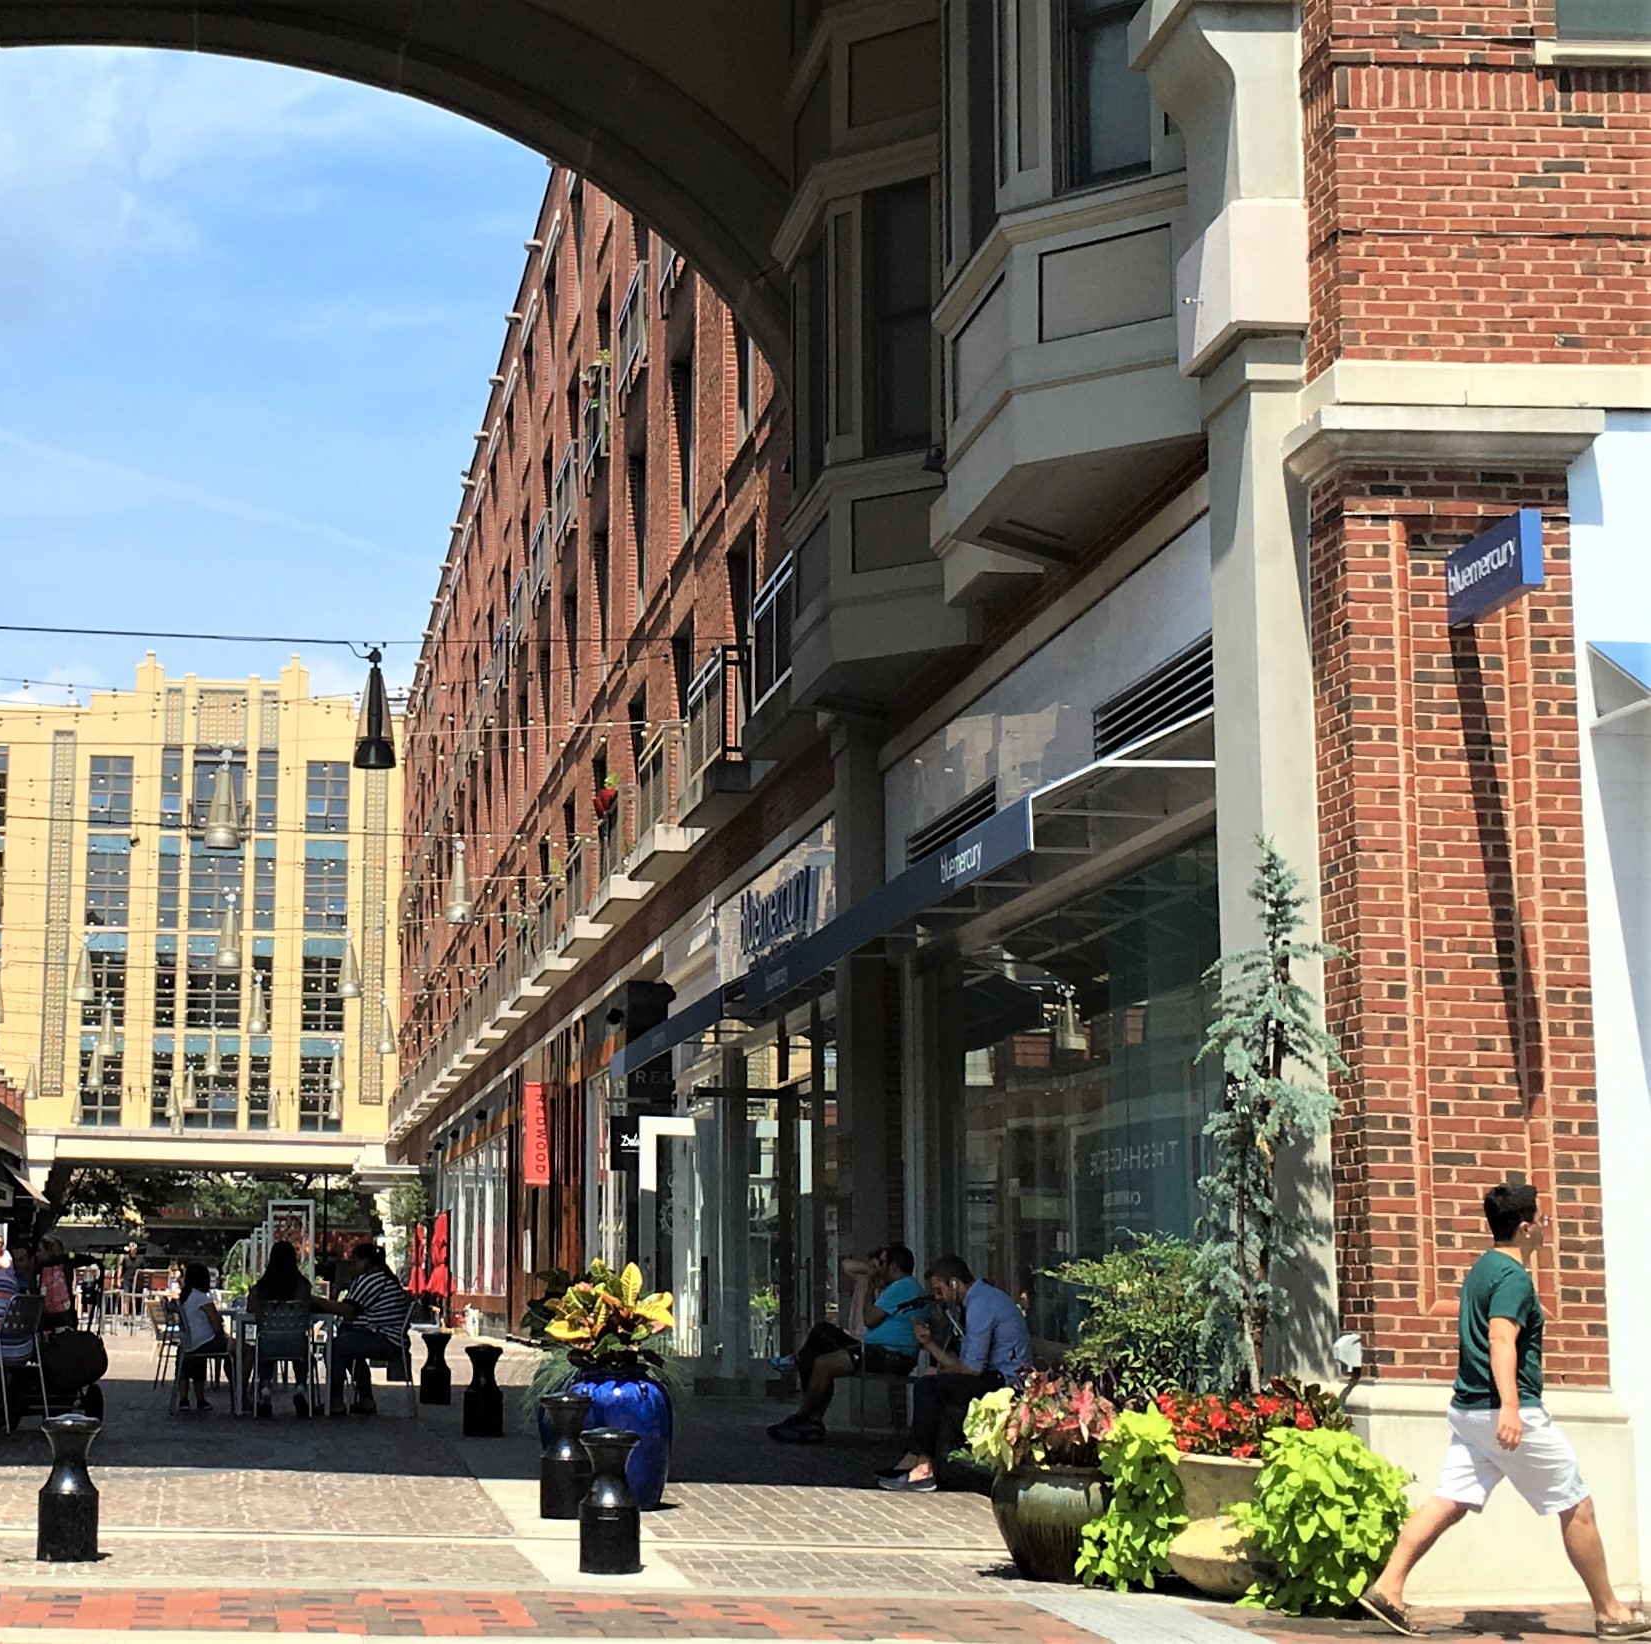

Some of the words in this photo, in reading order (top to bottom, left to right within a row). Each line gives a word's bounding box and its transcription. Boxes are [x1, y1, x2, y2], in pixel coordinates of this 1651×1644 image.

[1448, 537, 1517, 596] bluemercury
[940, 840, 982, 884] bluemercury
[535, 1094, 547, 1174] REDWOOD
